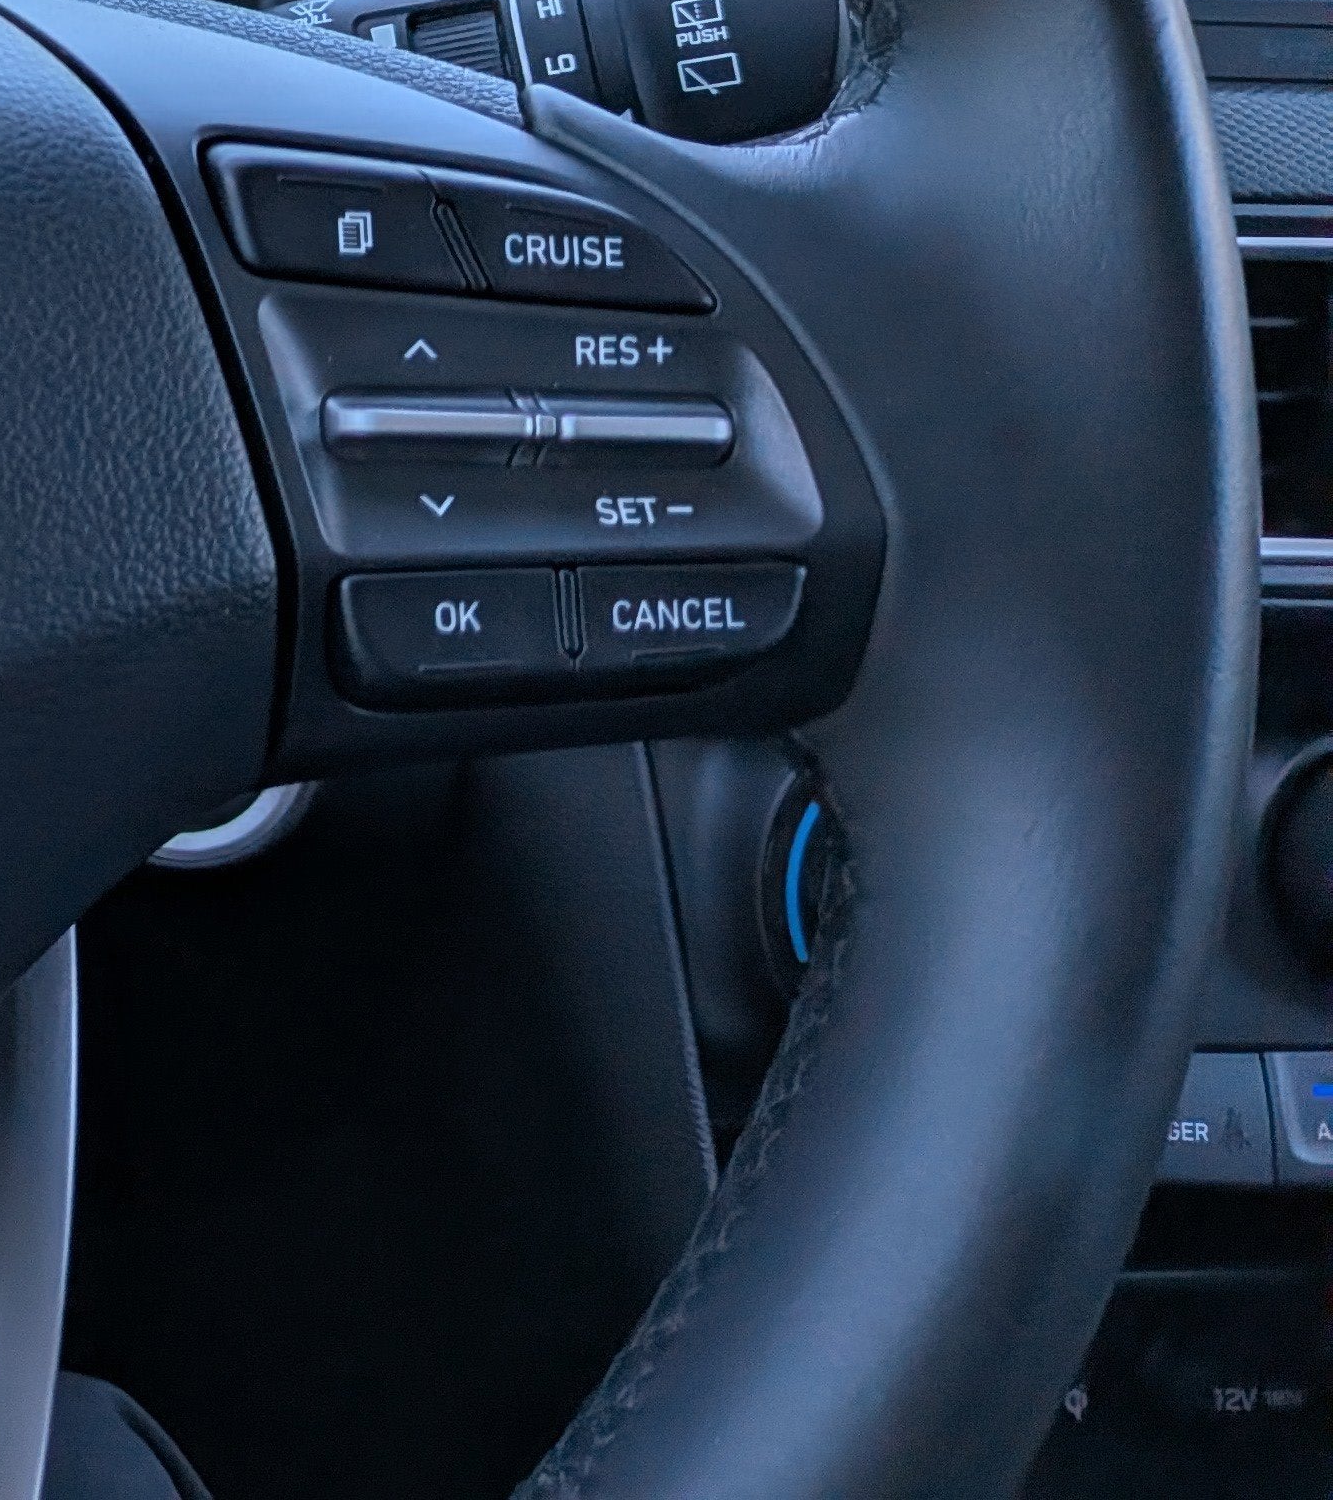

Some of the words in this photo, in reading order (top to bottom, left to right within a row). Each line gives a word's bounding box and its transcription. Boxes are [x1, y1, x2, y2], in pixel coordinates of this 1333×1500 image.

[675, 25, 729, 48] PUSH
[544, 53, 577, 76] LO
[504, 234, 624, 268] CRUISE
[435, 601, 481, 633] OK
[612, 599, 746, 631] CANCEL
[1214, 1386, 1258, 1411] 12V
